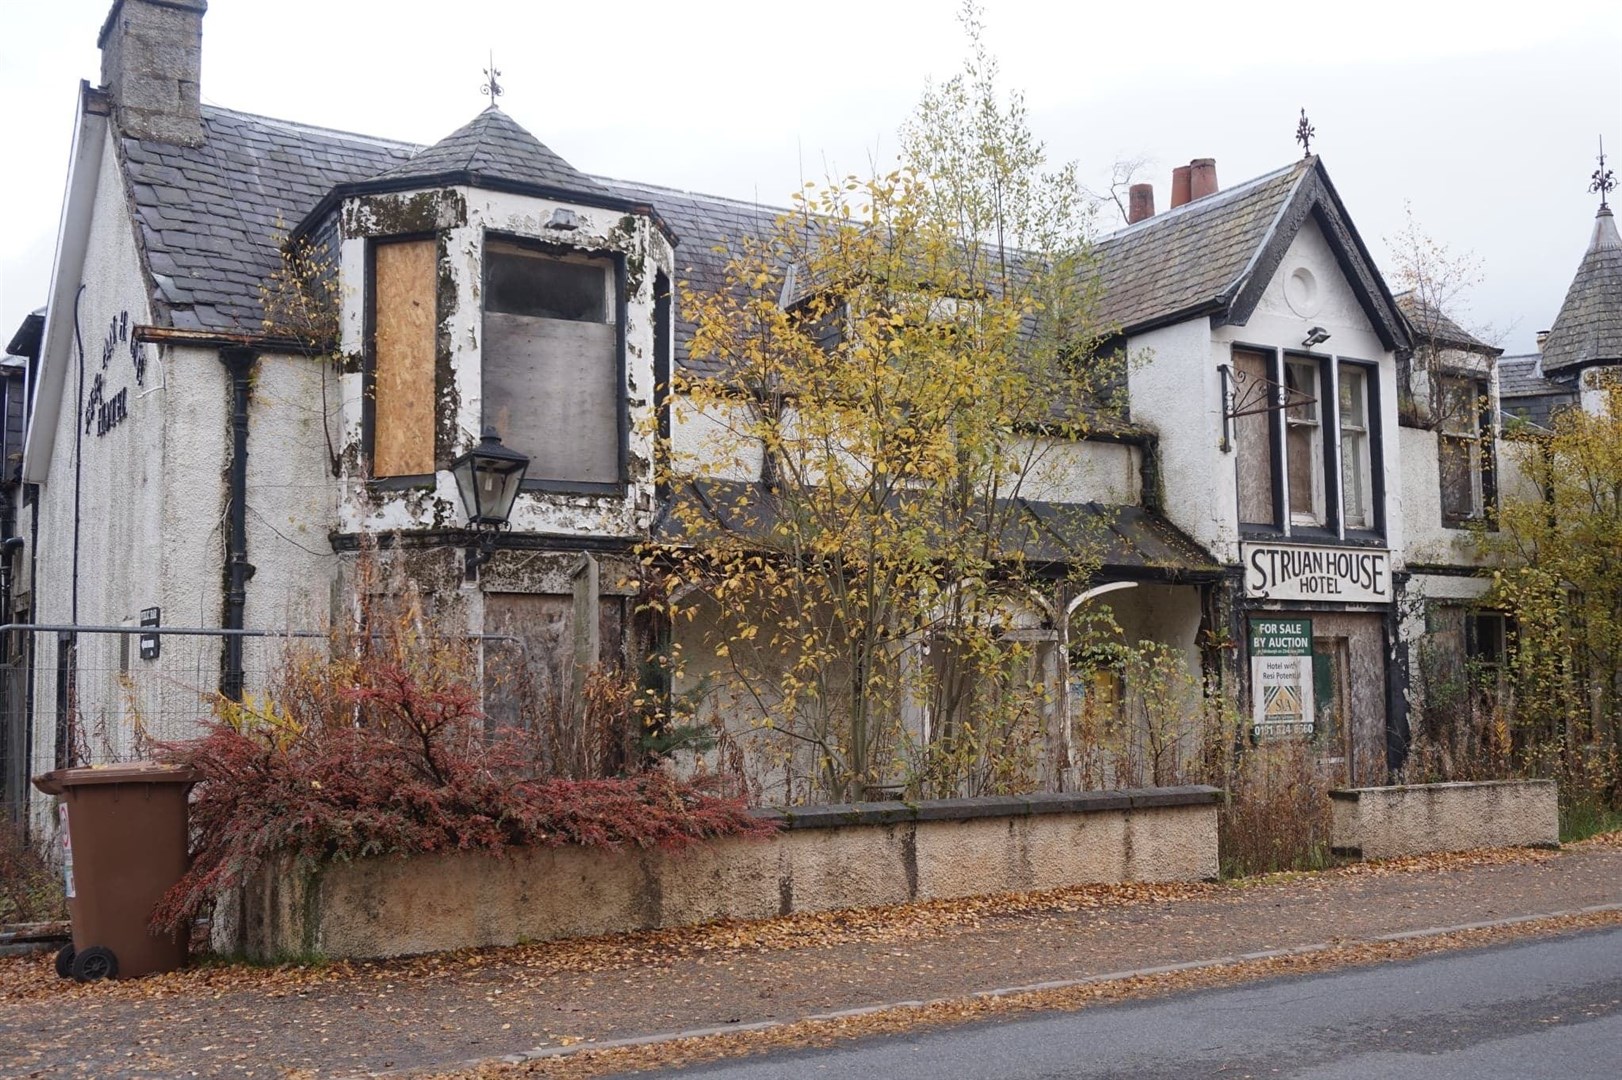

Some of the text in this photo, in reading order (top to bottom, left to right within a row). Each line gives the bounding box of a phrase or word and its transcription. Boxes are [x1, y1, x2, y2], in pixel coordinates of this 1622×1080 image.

[1251, 548, 1386, 596] STRUAN HOUSE
[1300, 576, 1342, 594] HOTEL
[1260, 623, 1302, 634] FOR SALE
[1253, 637, 1308, 648] BY AUCTION
[1267, 662, 1283, 670] Hotel
[1263, 672, 1275, 680] Resi
